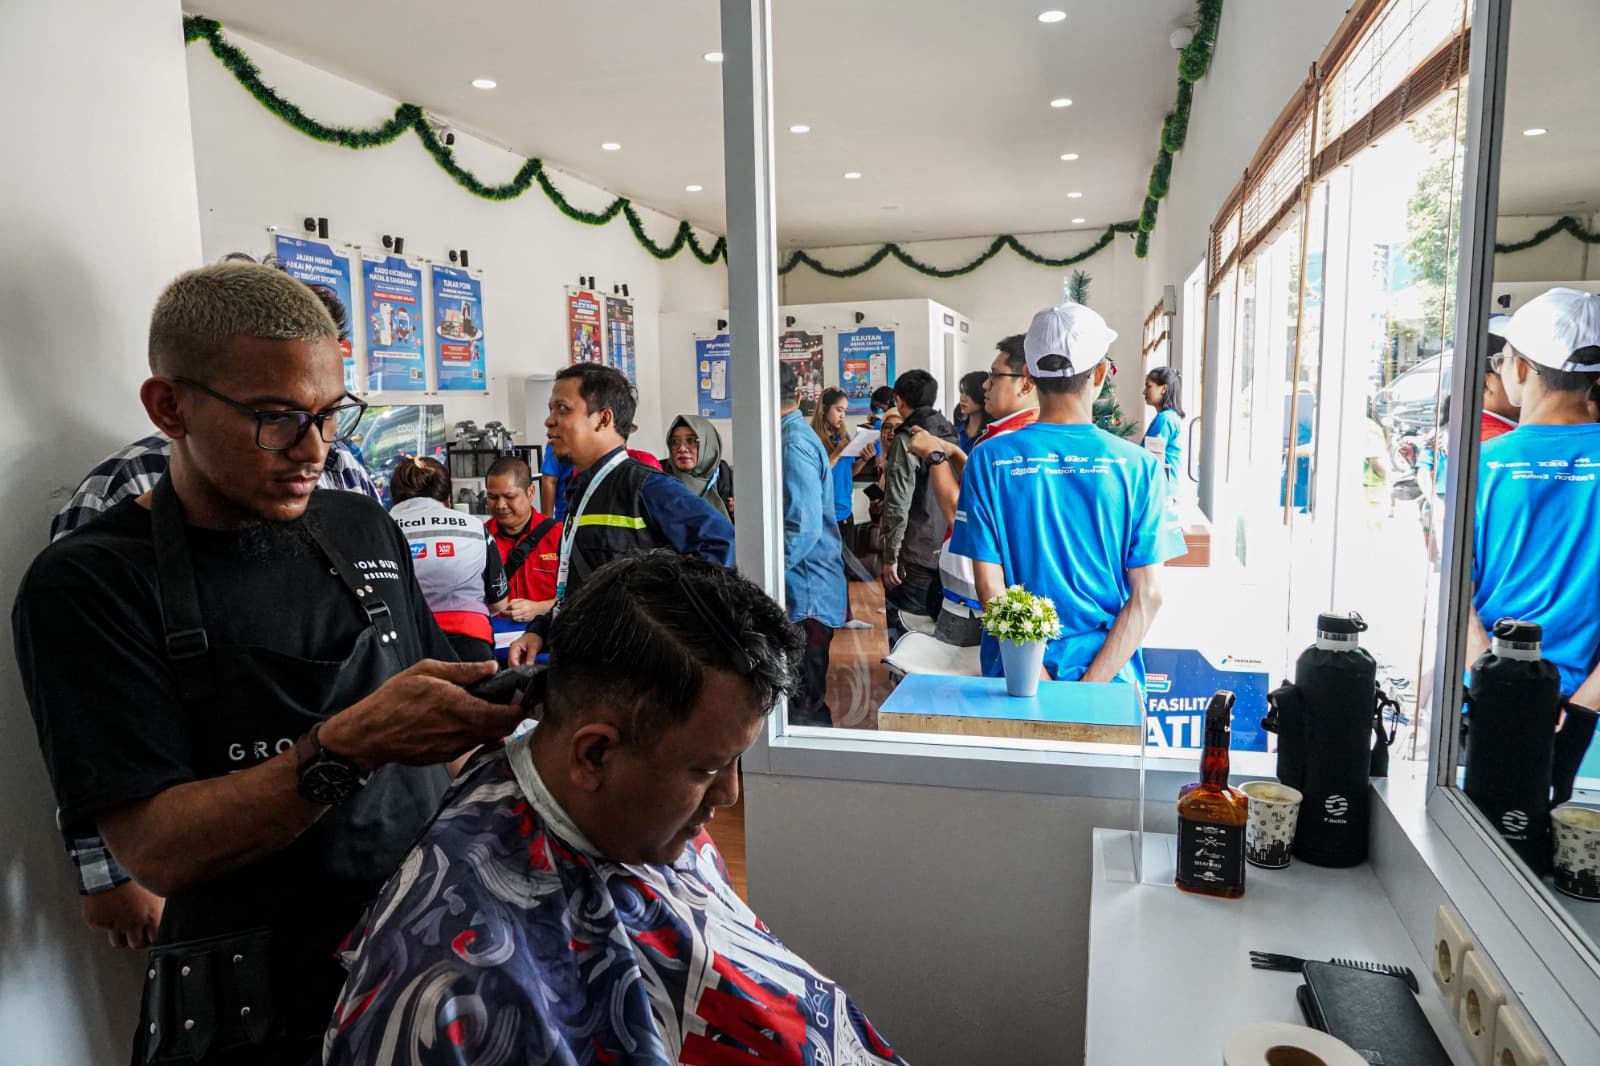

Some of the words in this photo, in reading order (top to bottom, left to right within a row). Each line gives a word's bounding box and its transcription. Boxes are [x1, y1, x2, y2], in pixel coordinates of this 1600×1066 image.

[396, 517, 426, 528] ical
[431, 517, 467, 527] RJBB
[1149, 697, 1213, 712] FASILIT
[1146, 715, 1202, 748] ATI
[228, 738, 294, 761] GRO
